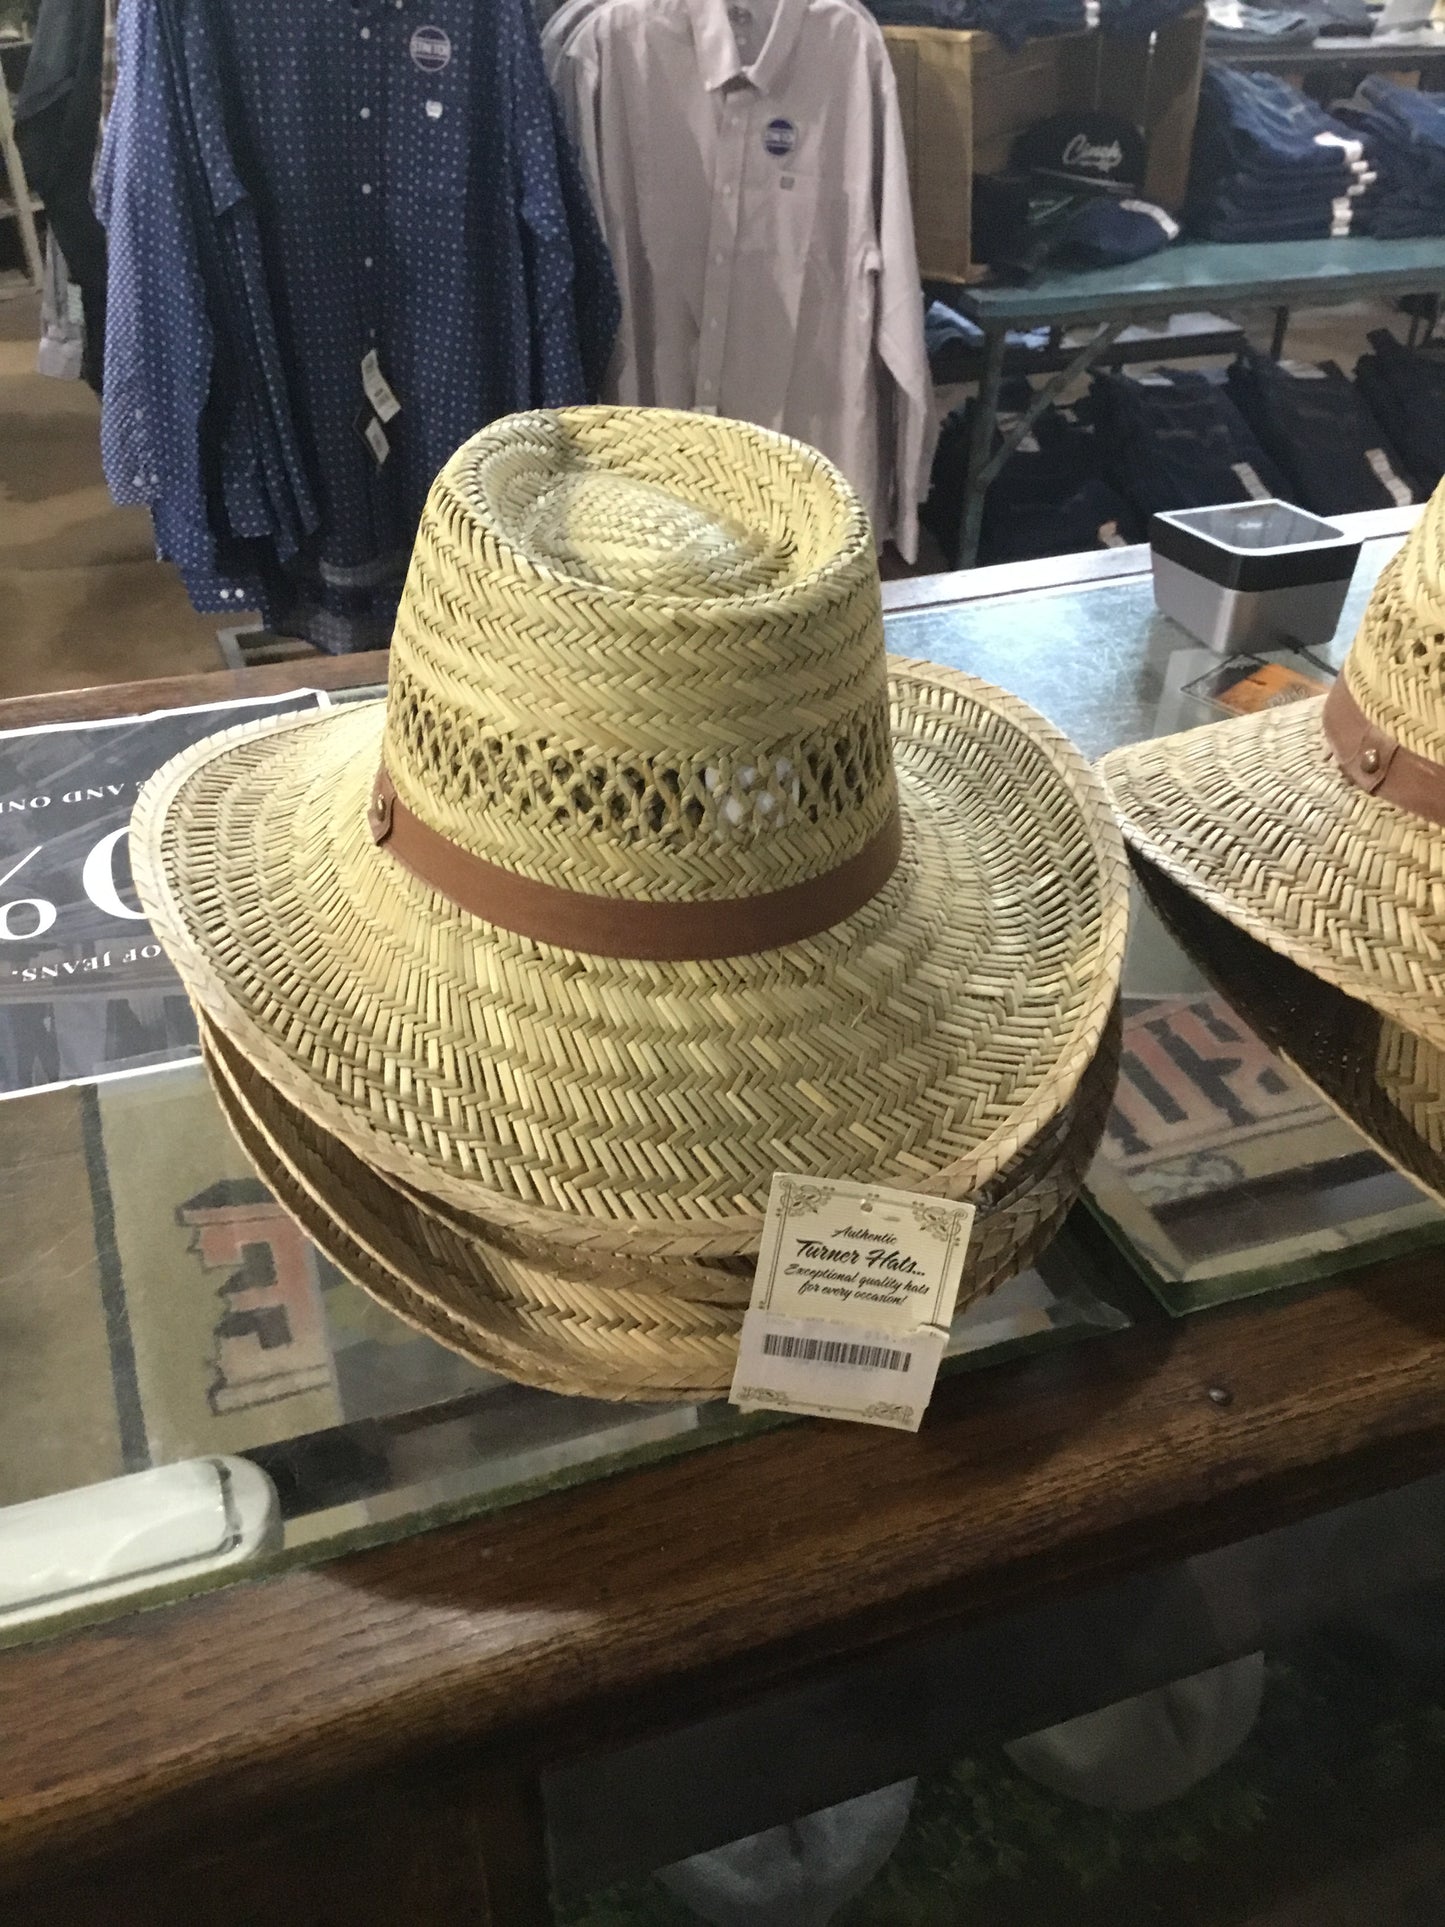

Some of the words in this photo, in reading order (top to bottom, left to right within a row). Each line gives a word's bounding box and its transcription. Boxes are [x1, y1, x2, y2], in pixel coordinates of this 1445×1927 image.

[62, 783, 125, 803] AND
[122, 944, 162, 963] OF
[12, 951, 111, 982] JEANS.
[832, 1226, 897, 1244] Authentic
[796, 1238, 859, 1265] Turner
[784, 1263, 859, 1283] Exceptional
[858, 1275, 903, 1295] quality
[904, 1280, 930, 1295] hats
[798, 1280, 820, 1295] for
[821, 1287, 853, 1302] every
[853, 1289, 907, 1305] occasion!
